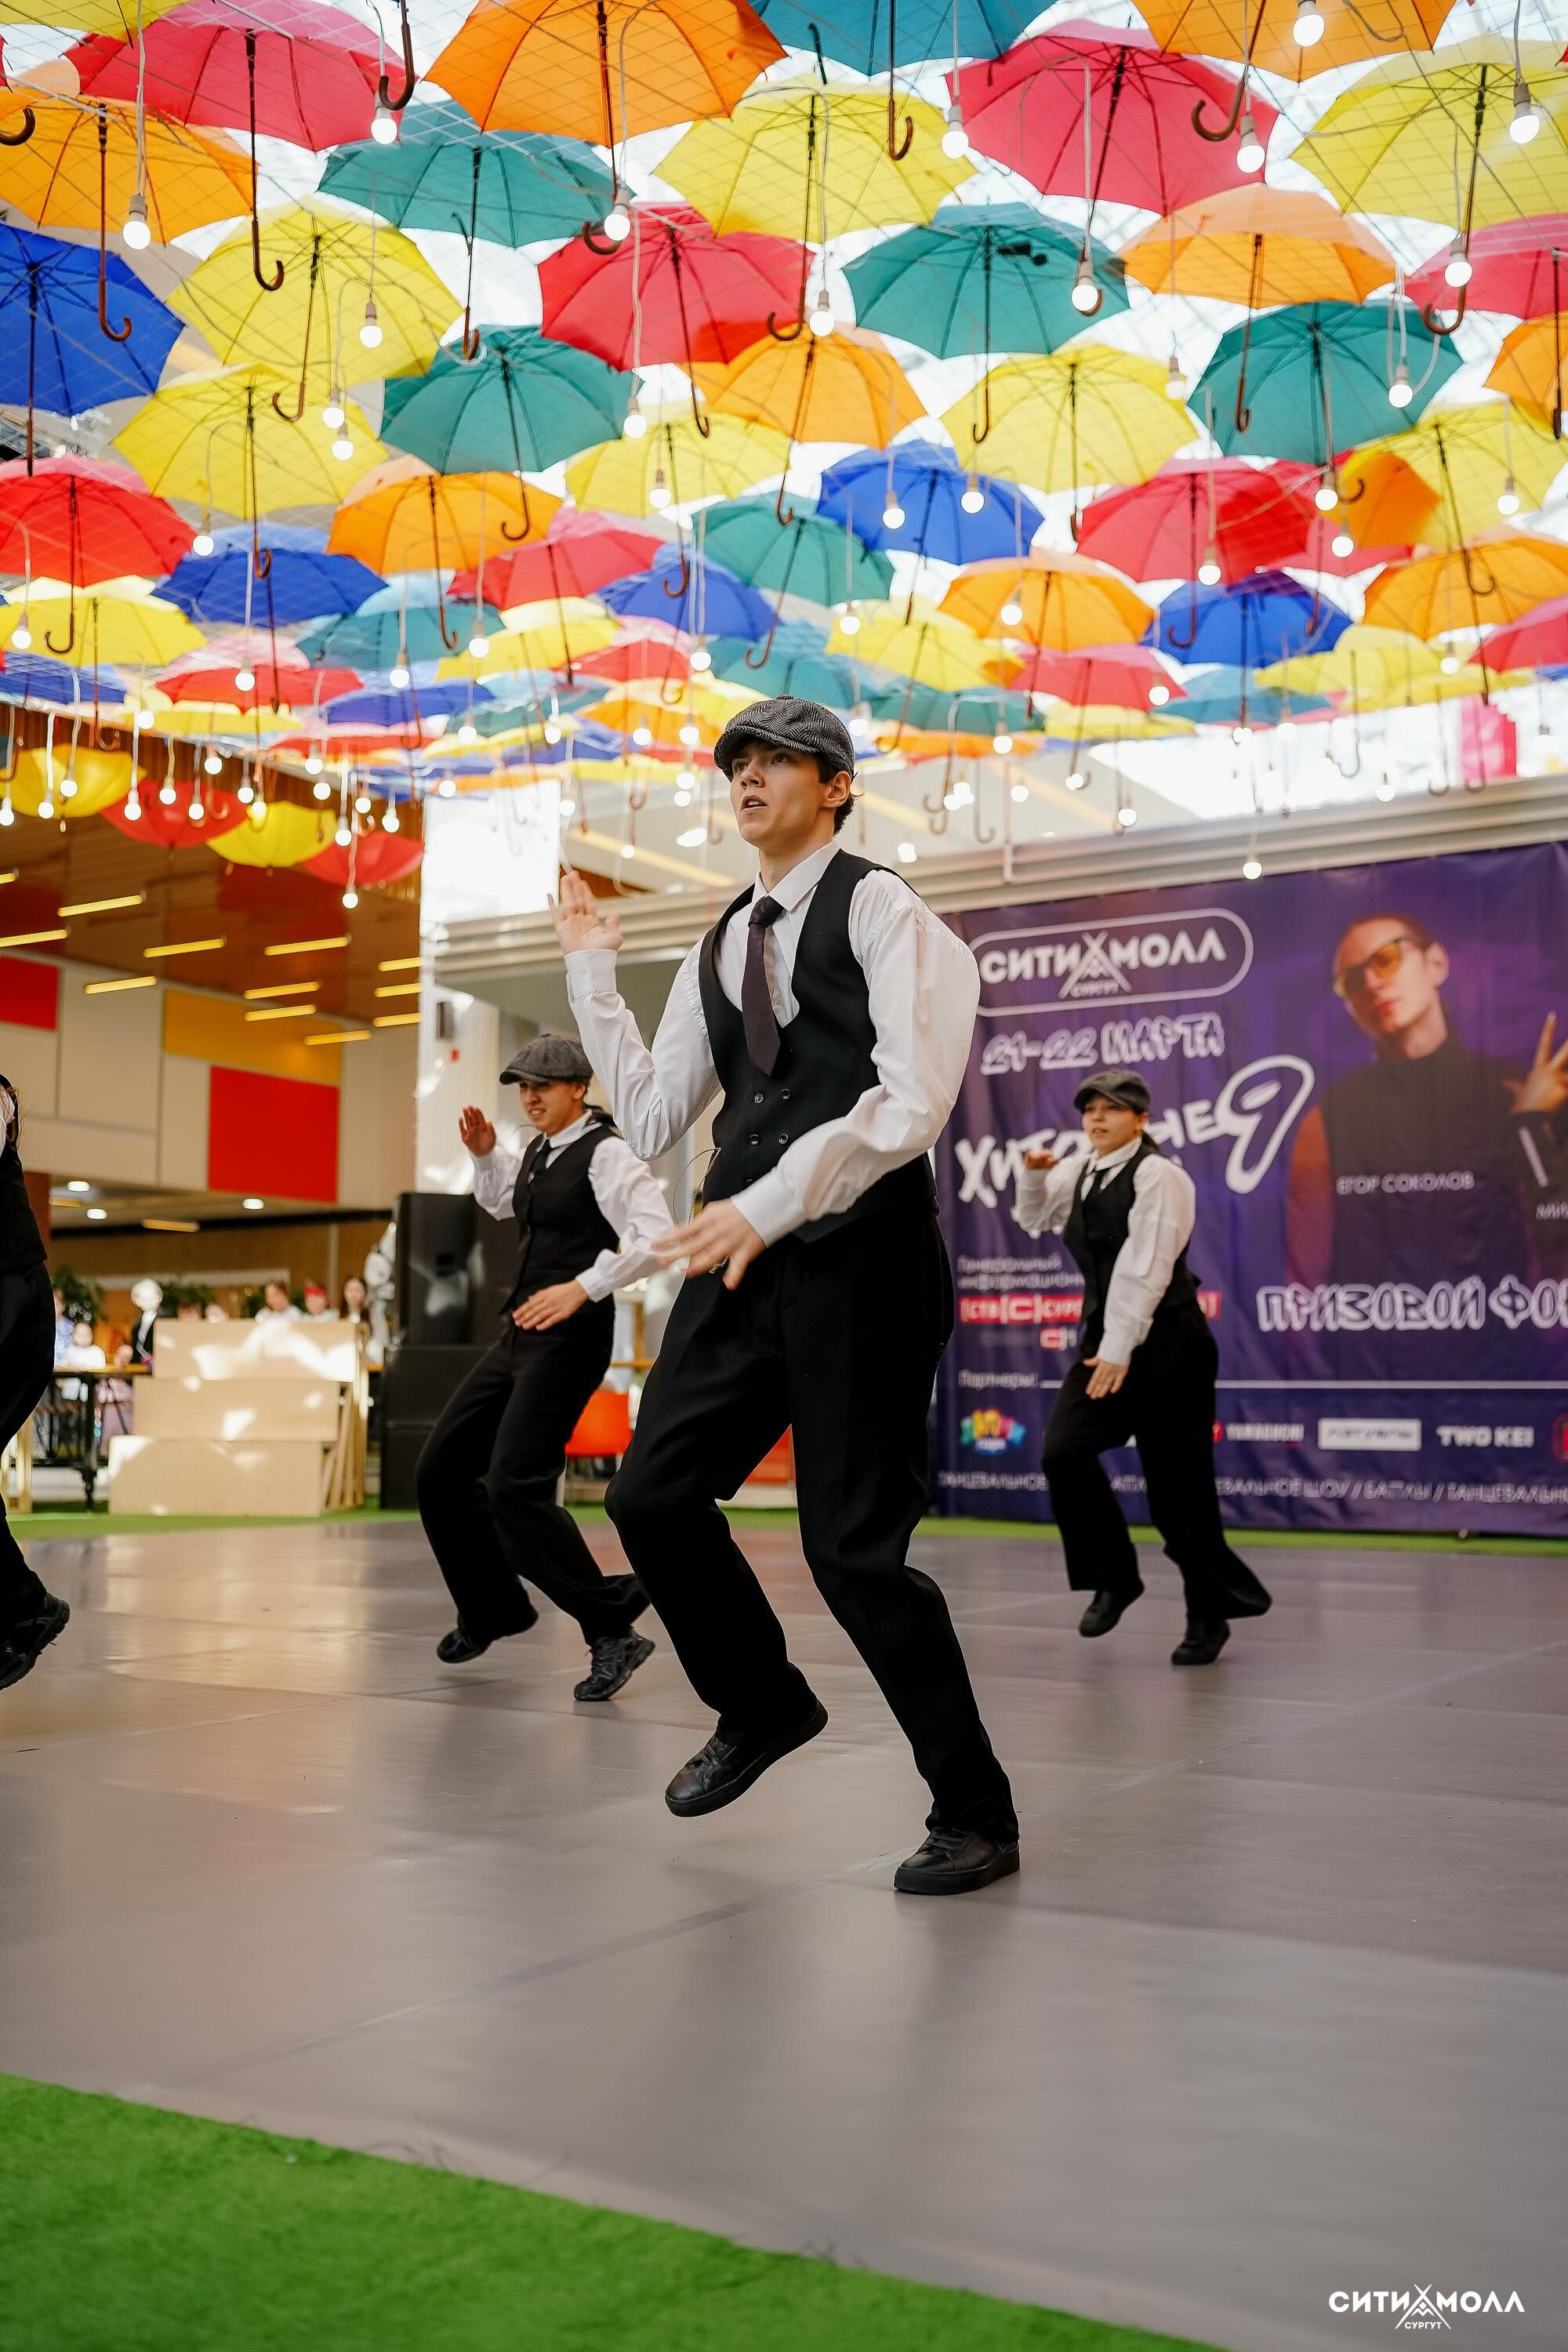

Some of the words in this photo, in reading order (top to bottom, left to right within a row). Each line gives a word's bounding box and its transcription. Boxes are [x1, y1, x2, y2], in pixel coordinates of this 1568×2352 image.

[979, 943, 1081, 985] СИТИ
[1109, 927, 1228, 970] МОЛЛ
[980, 1027, 1098, 1076] 21-22
[1100, 1011, 1225, 1065] МАРТА
[1336, 1175, 1381, 1195] ЕГОР
[1381, 1170, 1475, 1193] СОКОЛОВ
[1255, 1274, 1486, 1332] ПРИЗОВОЙ
[1436, 1425, 1492, 1447] TWO
[1303, 1478, 1352, 1498] ШОУ
